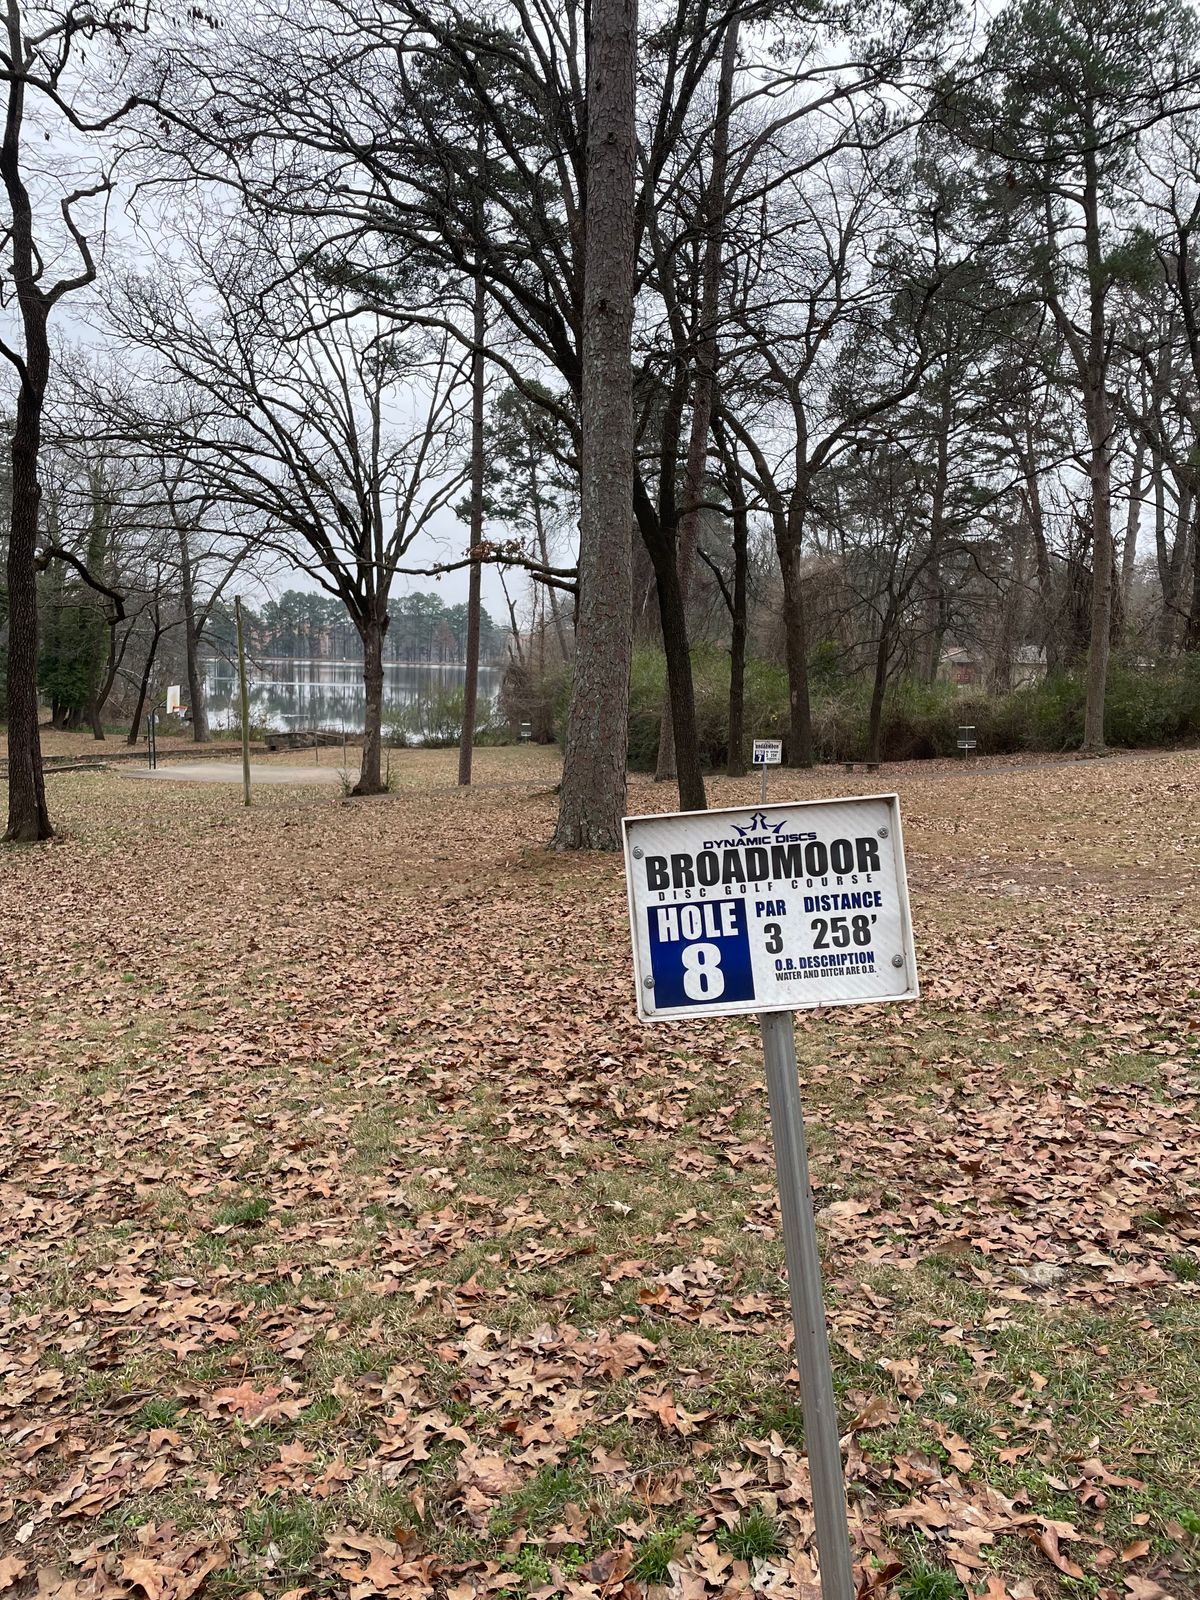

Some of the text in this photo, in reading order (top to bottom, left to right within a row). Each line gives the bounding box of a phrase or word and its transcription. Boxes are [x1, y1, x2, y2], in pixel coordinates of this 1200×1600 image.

[703, 831, 818, 850] DYNAMIC DISCS
[645, 837, 881, 891] BROADMOOR
[658, 873, 873, 901] DISC GOLF COURSE
[755, 891, 882, 918] PAR DISTANCE
[656, 901, 739, 943] HOLE
[763, 914, 878, 954] 3 258'
[681, 942, 725, 1001] 8
[775, 951, 875, 971] O.B. DESCRIPTION
[775, 964, 877, 981] WATER AND DITCH ARE O.B.
